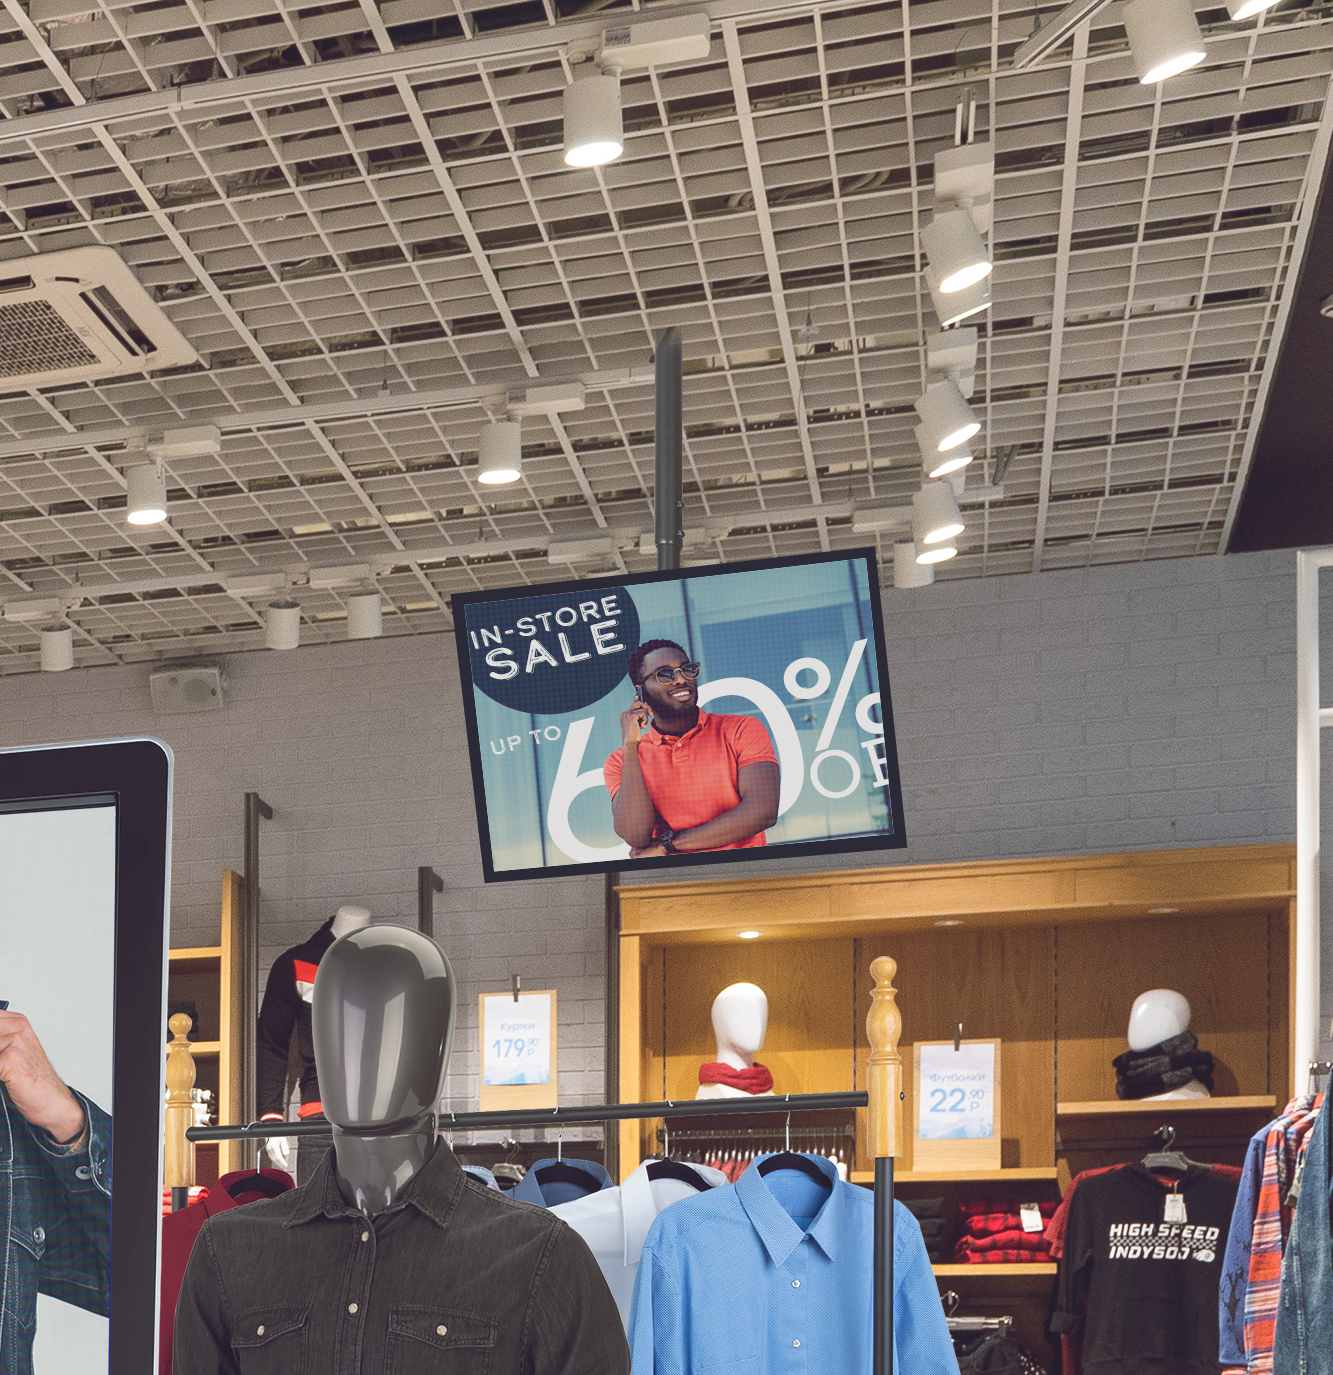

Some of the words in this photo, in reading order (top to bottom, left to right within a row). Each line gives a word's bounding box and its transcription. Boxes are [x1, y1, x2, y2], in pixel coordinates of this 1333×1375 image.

[469, 594, 622, 650] IN-STORE
[485, 619, 627, 680] SALE
[490, 735, 522, 755] UP
[529, 725, 562, 745] TO
[930, 1073, 986, 1084] Футболки
[1109, 1223, 1154, 1237] HIGH
